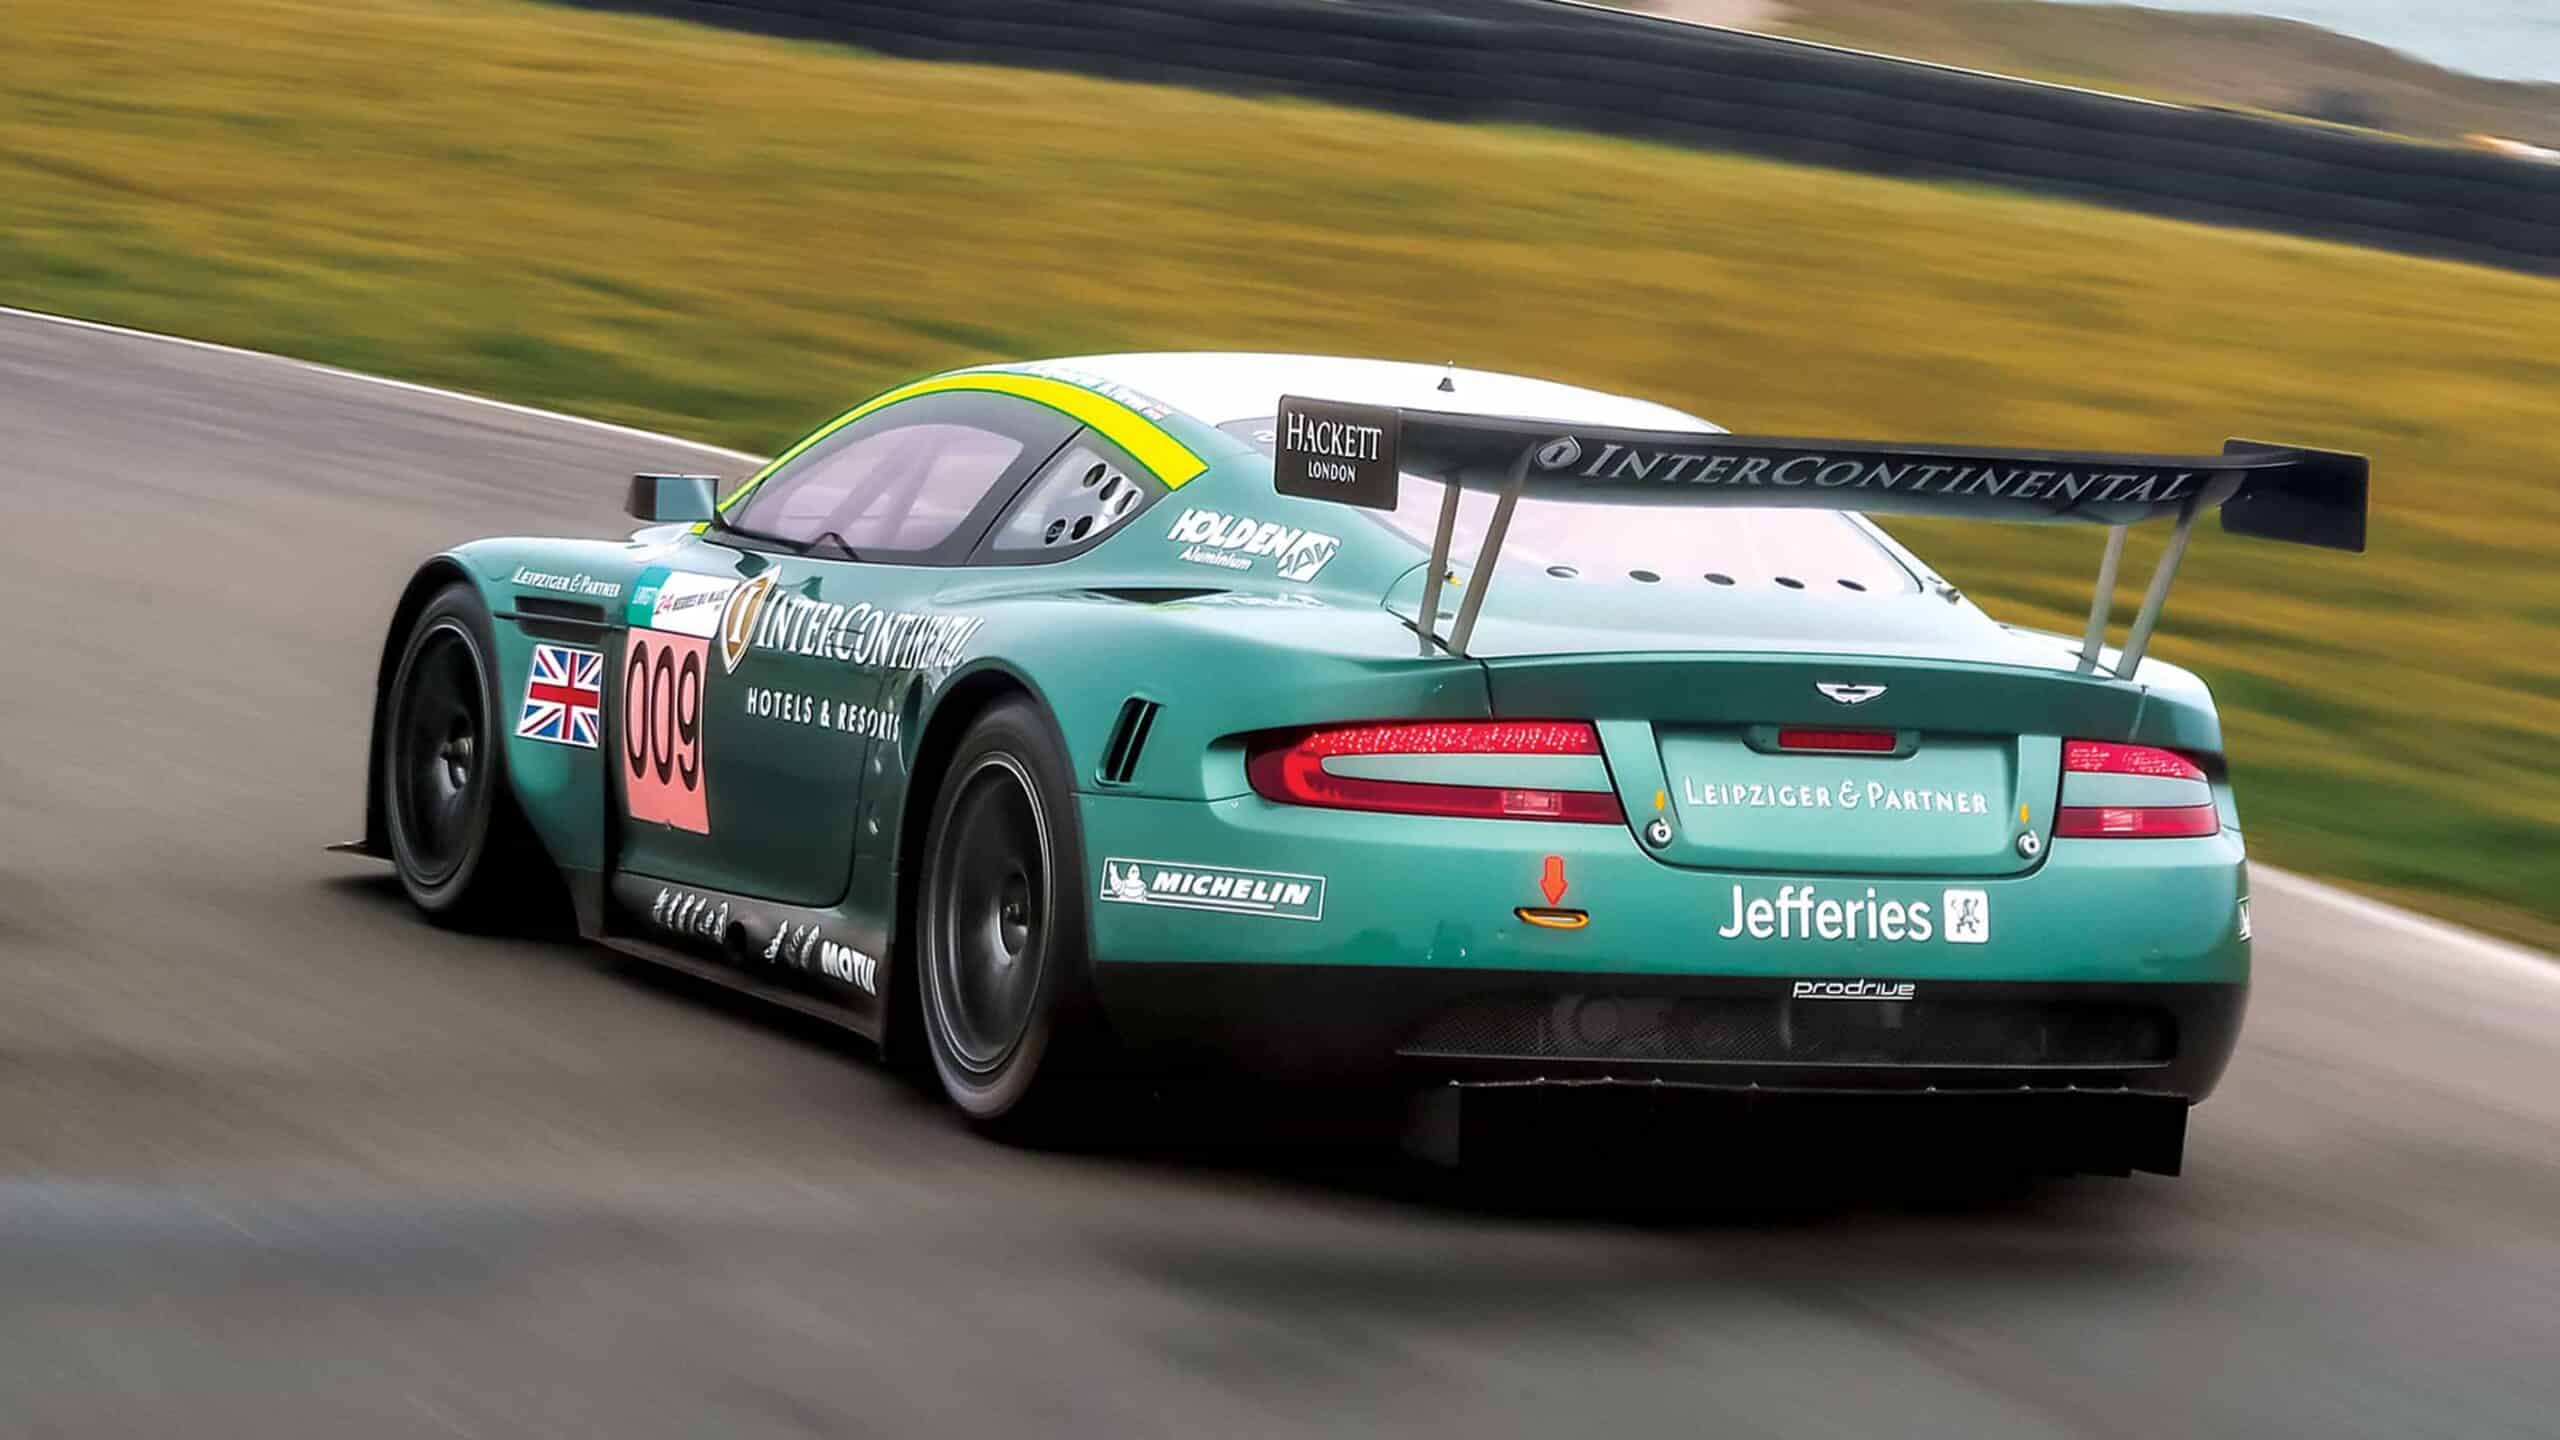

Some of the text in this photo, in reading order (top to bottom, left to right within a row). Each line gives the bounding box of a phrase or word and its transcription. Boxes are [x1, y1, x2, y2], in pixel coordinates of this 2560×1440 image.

[1286, 412, 1383, 460] HACKETT
[1308, 461, 1356, 483] LONDON
[1580, 444, 2192, 501] INTERCONTINENTAL
[1168, 508, 1300, 558] HOLDEN
[512, 567, 568, 590] LEIPZIGER
[569, 574, 580, 592] &
[580, 576, 621, 597] PARTNER
[1179, 546, 1252, 570] Aluminium
[757, 590, 984, 669] INTERCONTINENTAL
[626, 640, 700, 792] 009
[747, 687, 901, 743] HOTELS & RESORTS
[1685, 776, 1988, 815] LEIPZIGER & PARTNER
[1152, 871, 1311, 904] MICHELIN
[1718, 884, 1932, 941] Jefferies
[1793, 978, 1915, 998] prodrive
